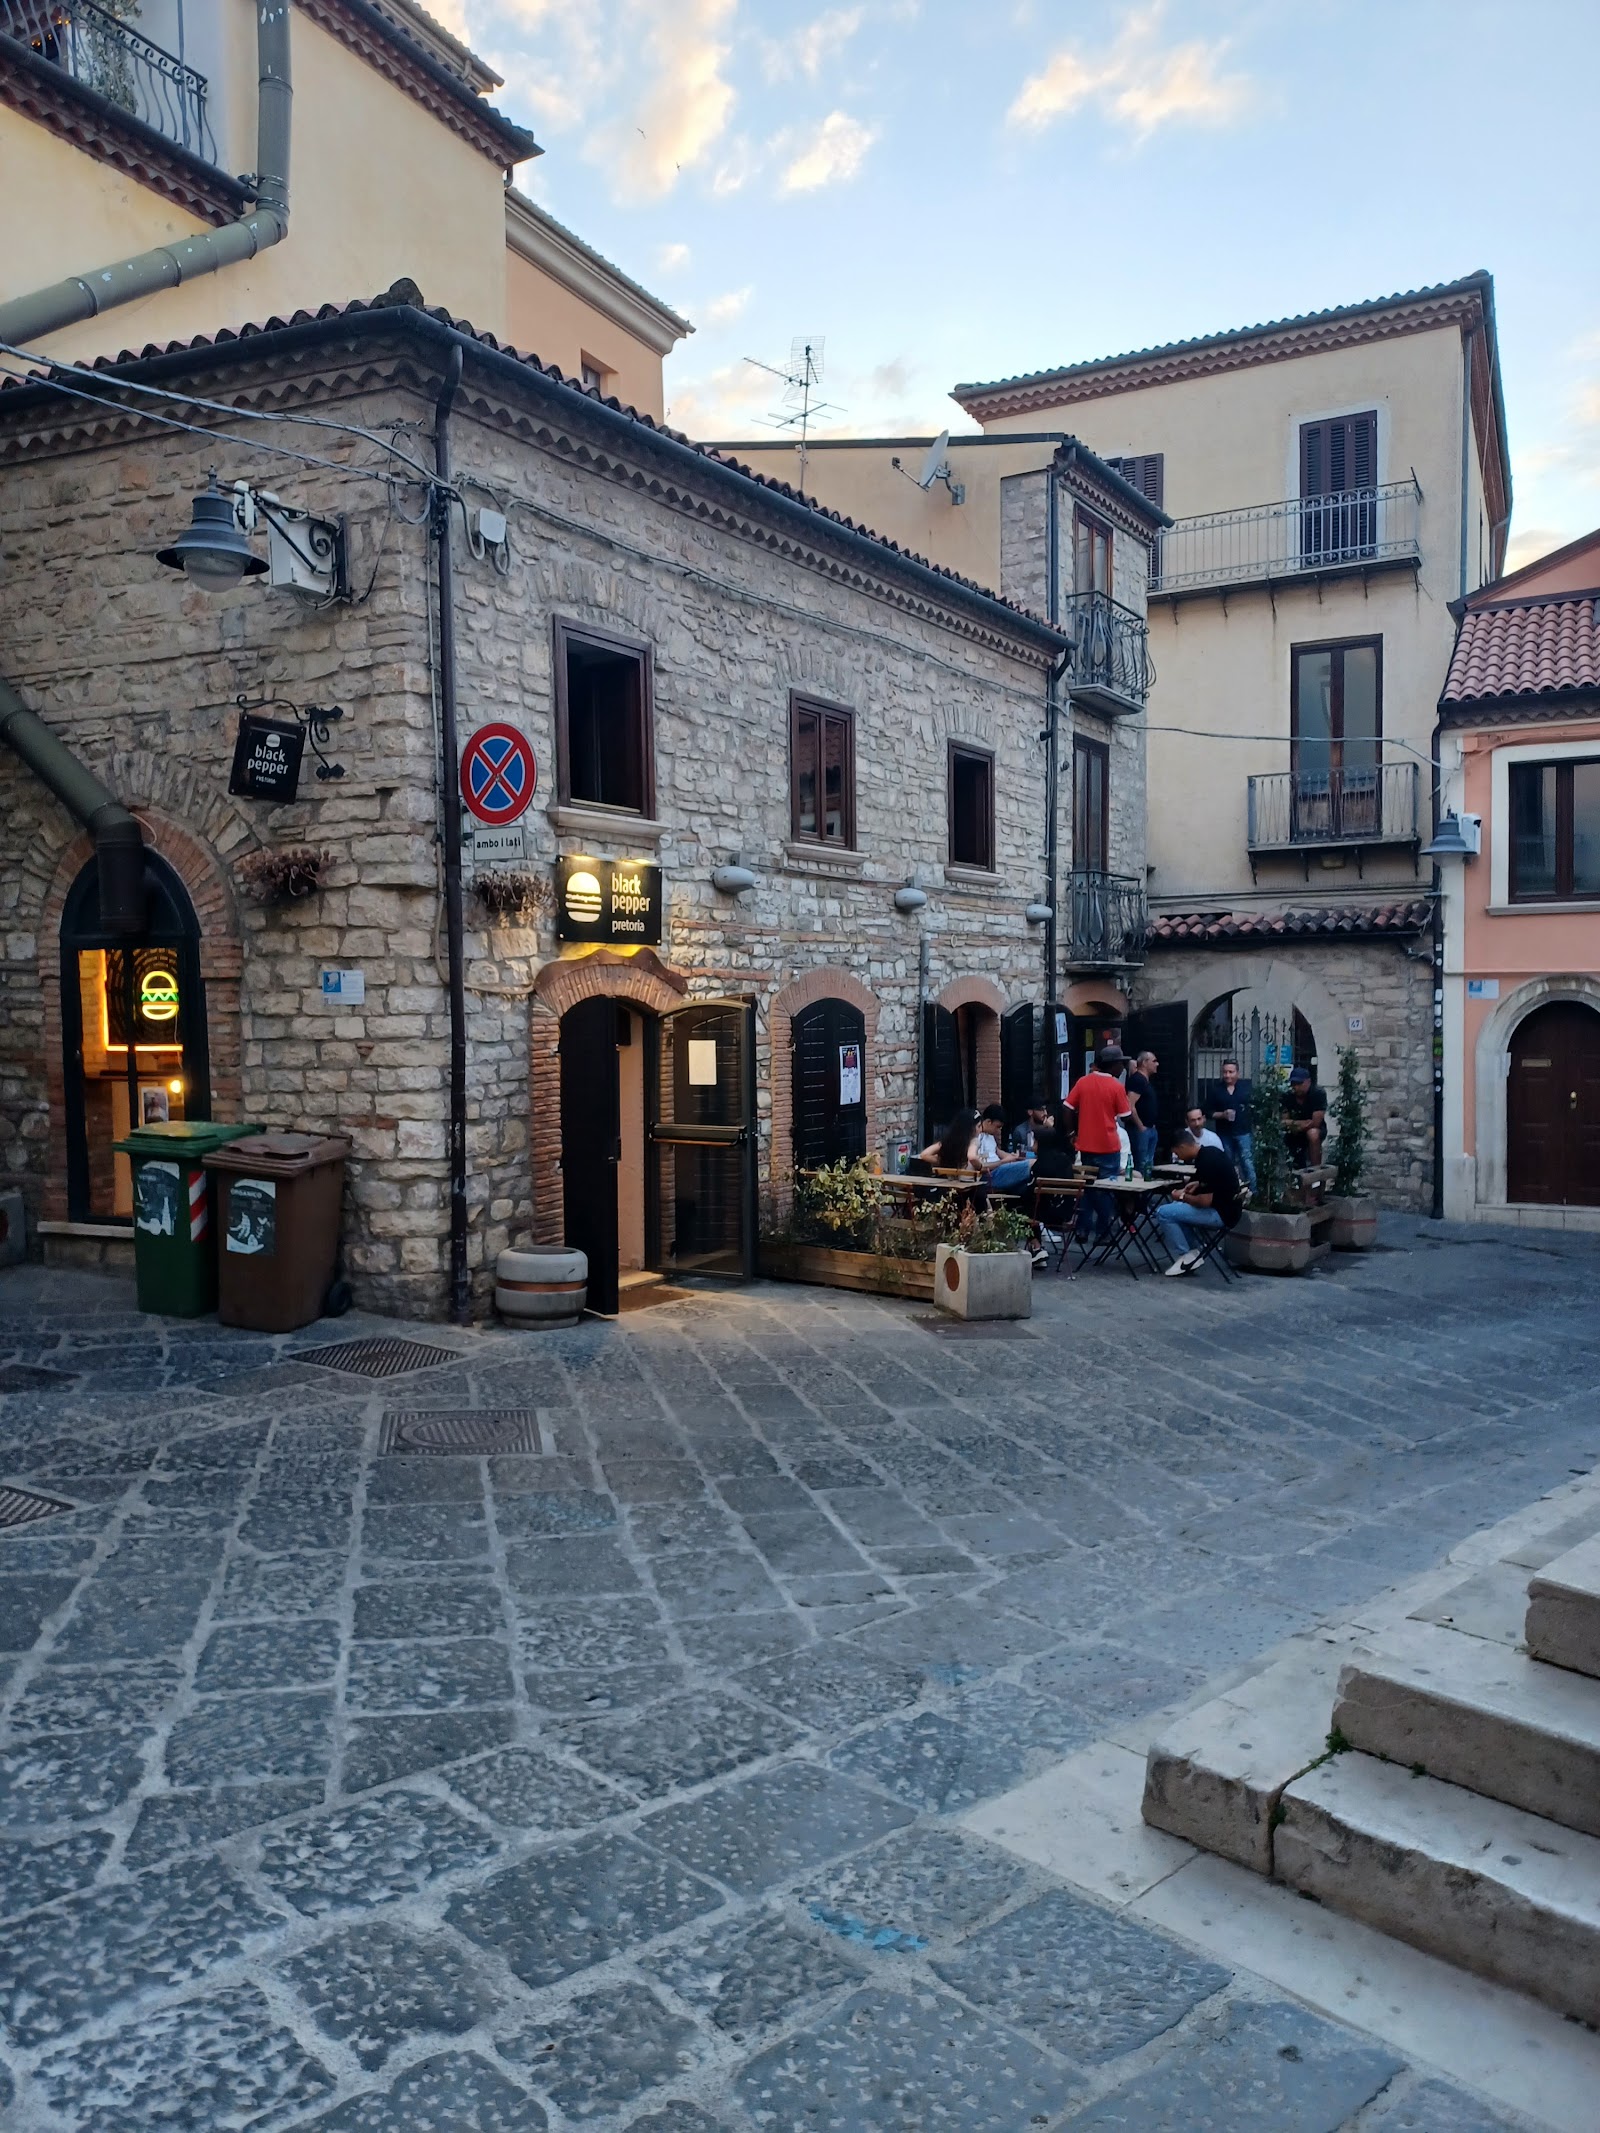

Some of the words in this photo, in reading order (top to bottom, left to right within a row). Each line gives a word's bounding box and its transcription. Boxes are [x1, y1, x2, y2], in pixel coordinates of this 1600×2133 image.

[255, 744, 286, 763] black
[247, 758, 289, 775] pepper
[476, 838, 499, 849] ambo
[505, 836, 521, 847] lati
[611, 872, 642, 895] black
[611, 894, 651, 916] pepper
[612, 919, 645, 934] pretoria
